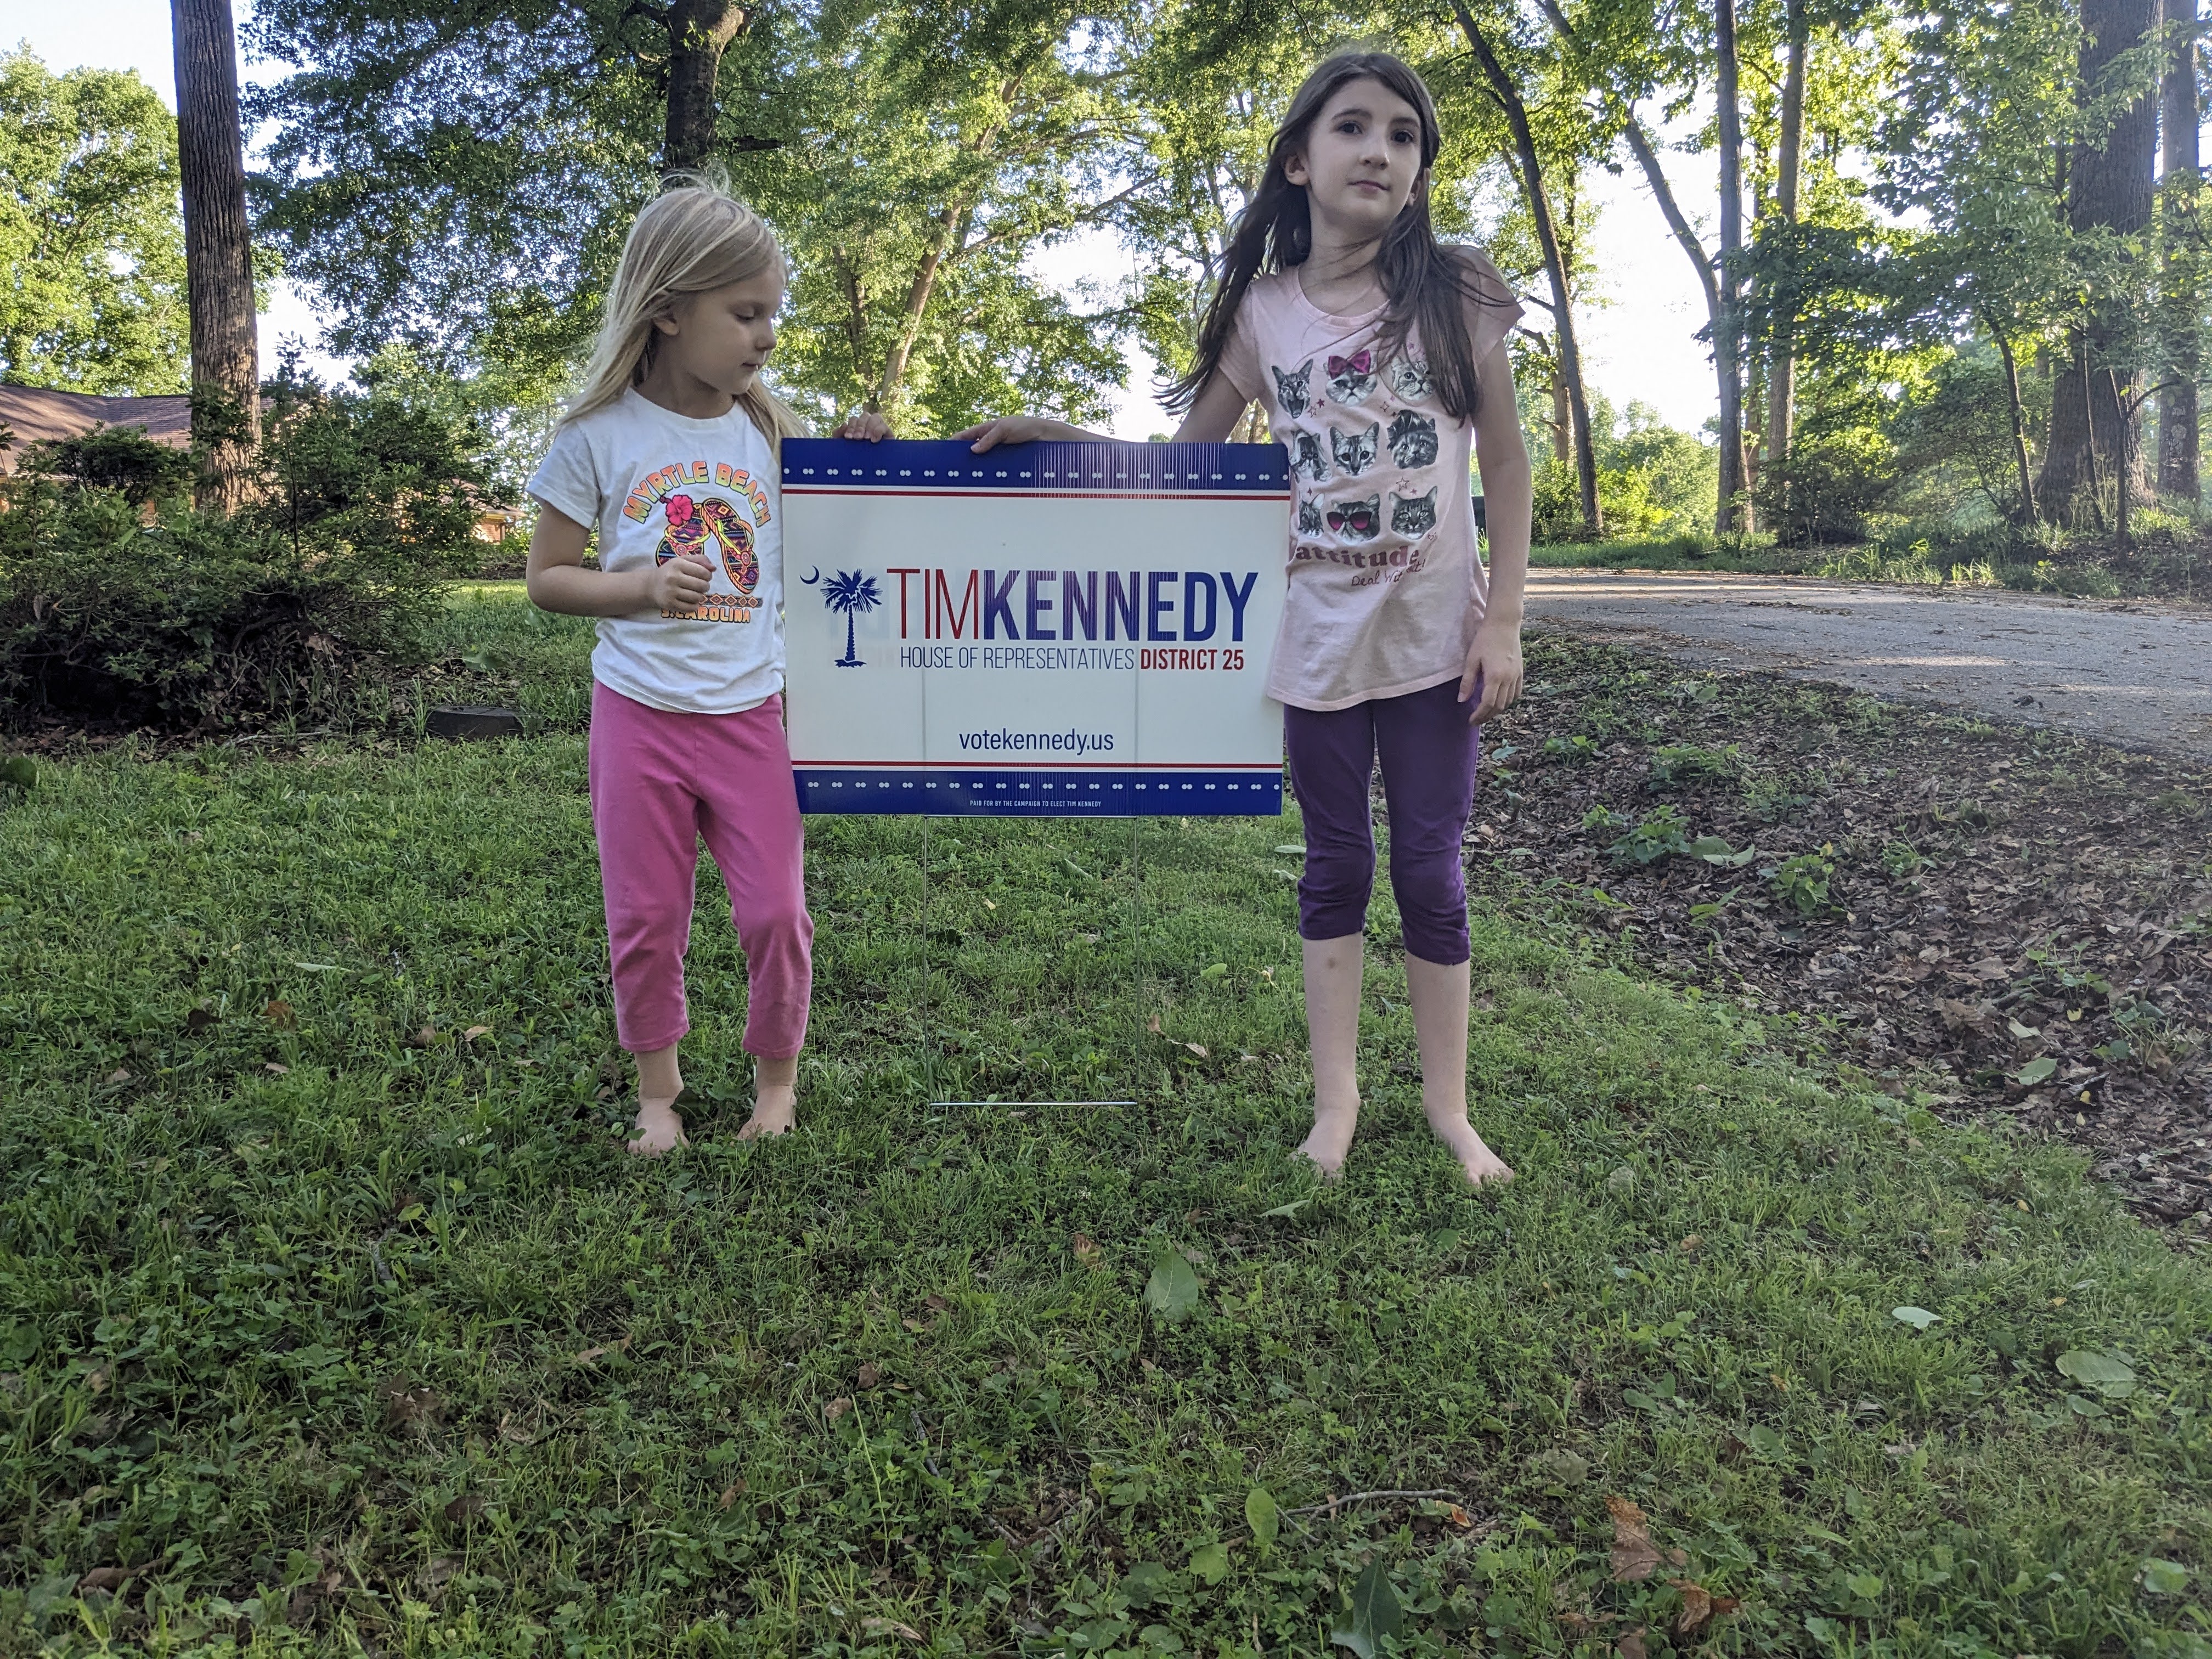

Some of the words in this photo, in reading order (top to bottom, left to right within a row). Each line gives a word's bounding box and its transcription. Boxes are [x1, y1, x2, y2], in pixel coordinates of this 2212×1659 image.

[623, 461, 709, 524] MYRTLE
[715, 462, 771, 528] BEACH
[1296, 545, 1419, 568] attitude
[1351, 570, 1380, 586] Deal
[900, 646, 953, 669] HOUSE
[958, 647, 978, 669] OF
[983, 647, 1135, 670] REPRESENTATIVES
[1140, 648, 1217, 670] DISTRICT
[1222, 649, 1244, 670] 25
[959, 727, 1114, 756] votekennedy.us
